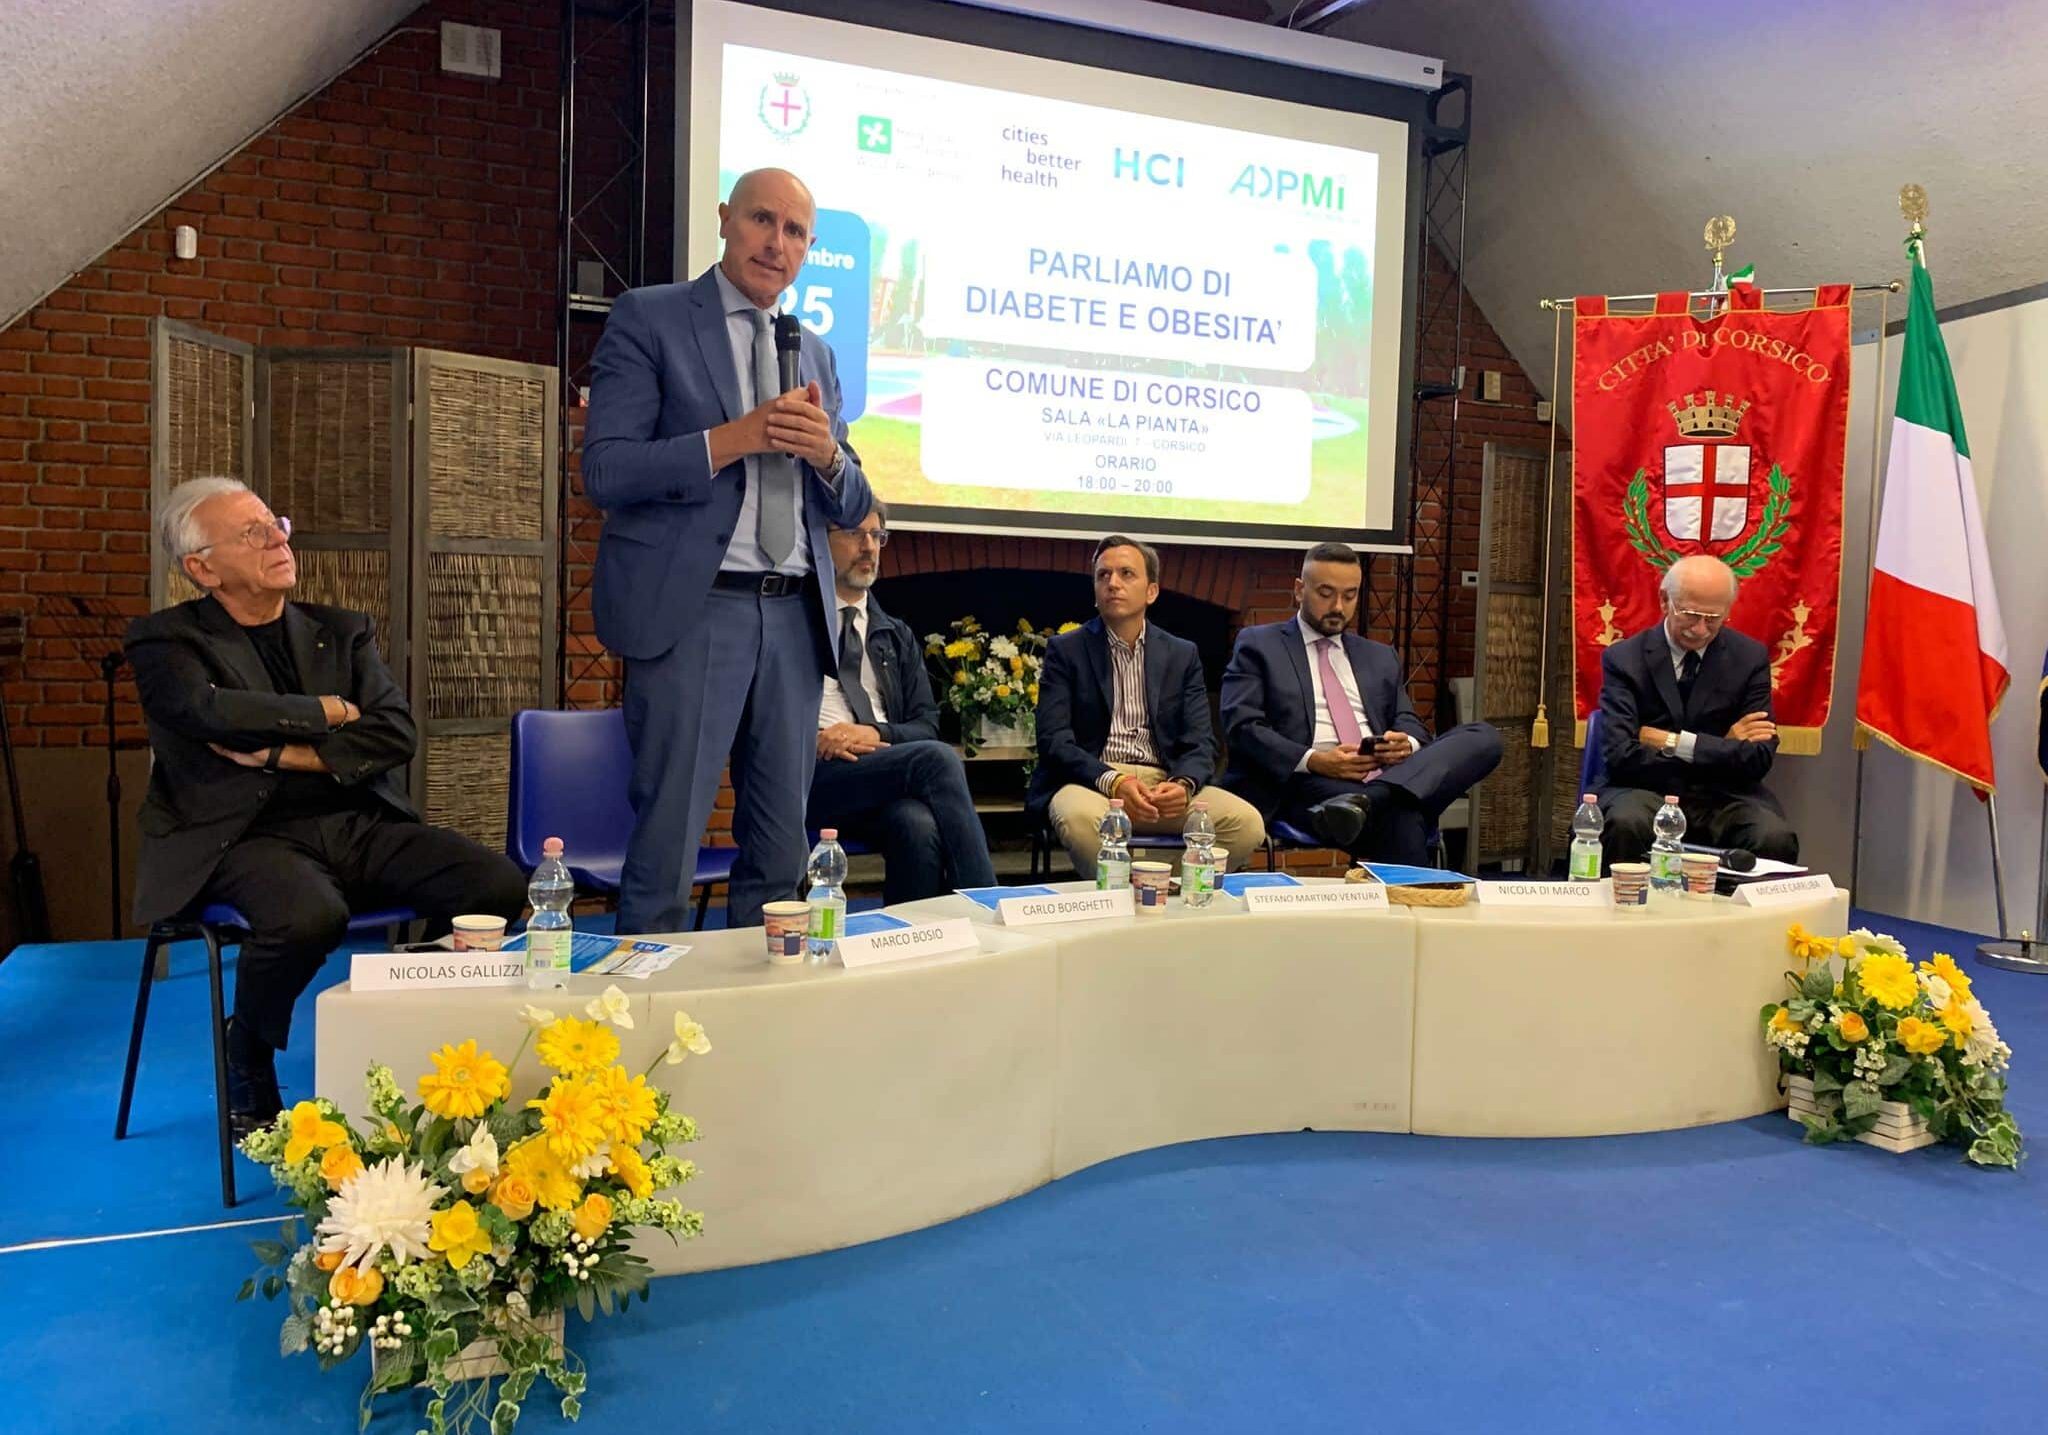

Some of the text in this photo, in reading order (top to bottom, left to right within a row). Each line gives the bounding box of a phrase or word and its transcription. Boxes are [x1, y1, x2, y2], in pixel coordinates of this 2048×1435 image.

[1001, 123, 1049, 147] cities
[1026, 147, 1082, 171] better
[1113, 147, 1186, 188] HCI
[1000, 165, 1059, 189] health
[1028, 248, 1231, 297] PARLIAMO DI
[965, 285, 1107, 327] DIABETE
[1119, 303, 1137, 330] E
[1682, 330, 1709, 349] DI
[1713, 327, 1831, 384] CORSICO
[984, 367, 1262, 413] COMUNE DI CORSICO
[1041, 407, 1091, 426] SALA
[1136, 415, 1209, 435] PIANTA»
[1043, 431, 1064, 443] VIA
[1067, 432, 1127, 447] LEOPARDI
[1152, 439, 1207, 453] CORSICO
[1094, 454, 1157, 472] ORARIO
[1077, 475, 1117, 492] 18:00
[1133, 478, 1173, 494] 20:00
[1254, 891, 1380, 904] STEFANO MARTINO VENTURA
[1498, 886, 1590, 896] NICOLA DI MARCO
[1755, 882, 1788, 896] MICHELE
[1022, 899, 1114, 916] CARLO BORGHETTI
[870, 928, 944, 950] MARCO BOSIO
[389, 963, 524, 981] NICOLAS GALLIZZI
